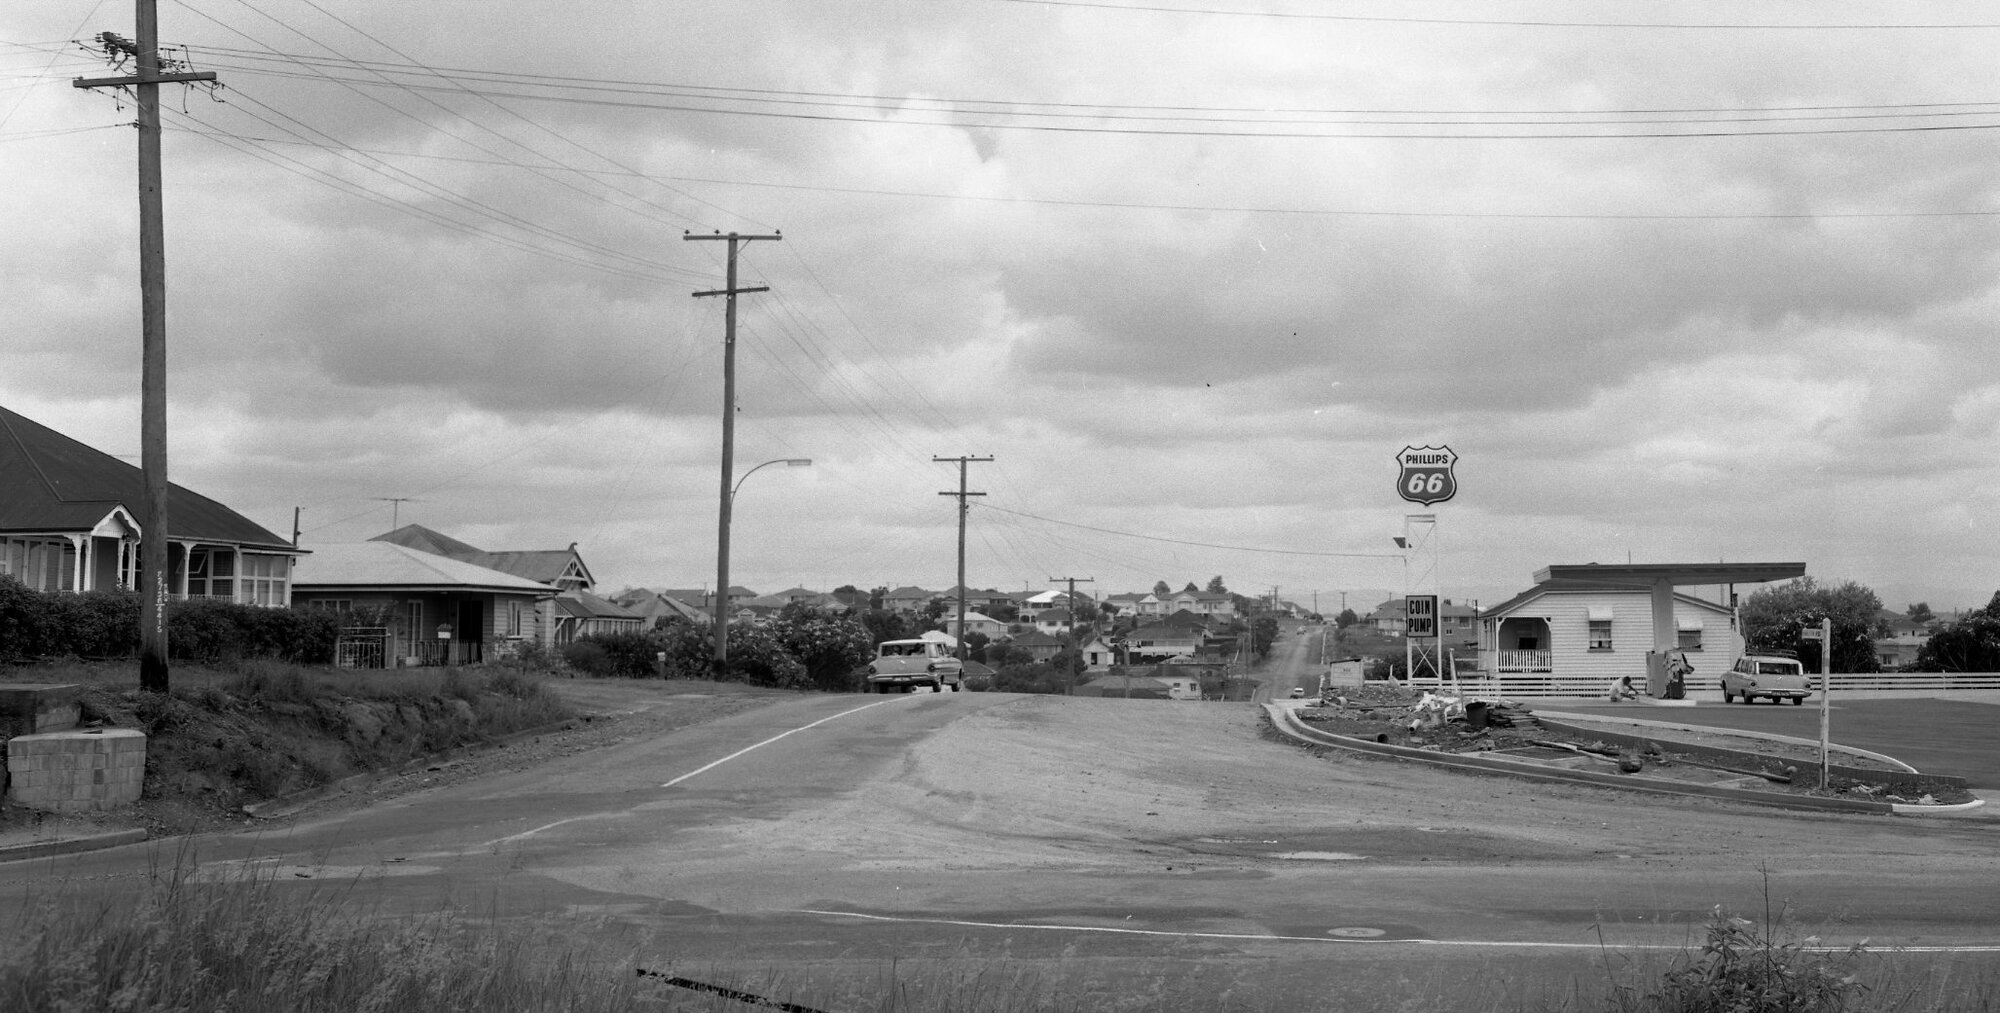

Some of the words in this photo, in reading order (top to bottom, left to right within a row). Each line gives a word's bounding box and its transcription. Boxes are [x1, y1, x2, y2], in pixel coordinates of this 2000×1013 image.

[1406, 454, 1448, 464] PHILLIPS
[1408, 472, 1445, 494] 66
[1409, 600, 1430, 614] COIN
[1408, 618, 1431, 633] PUMP
